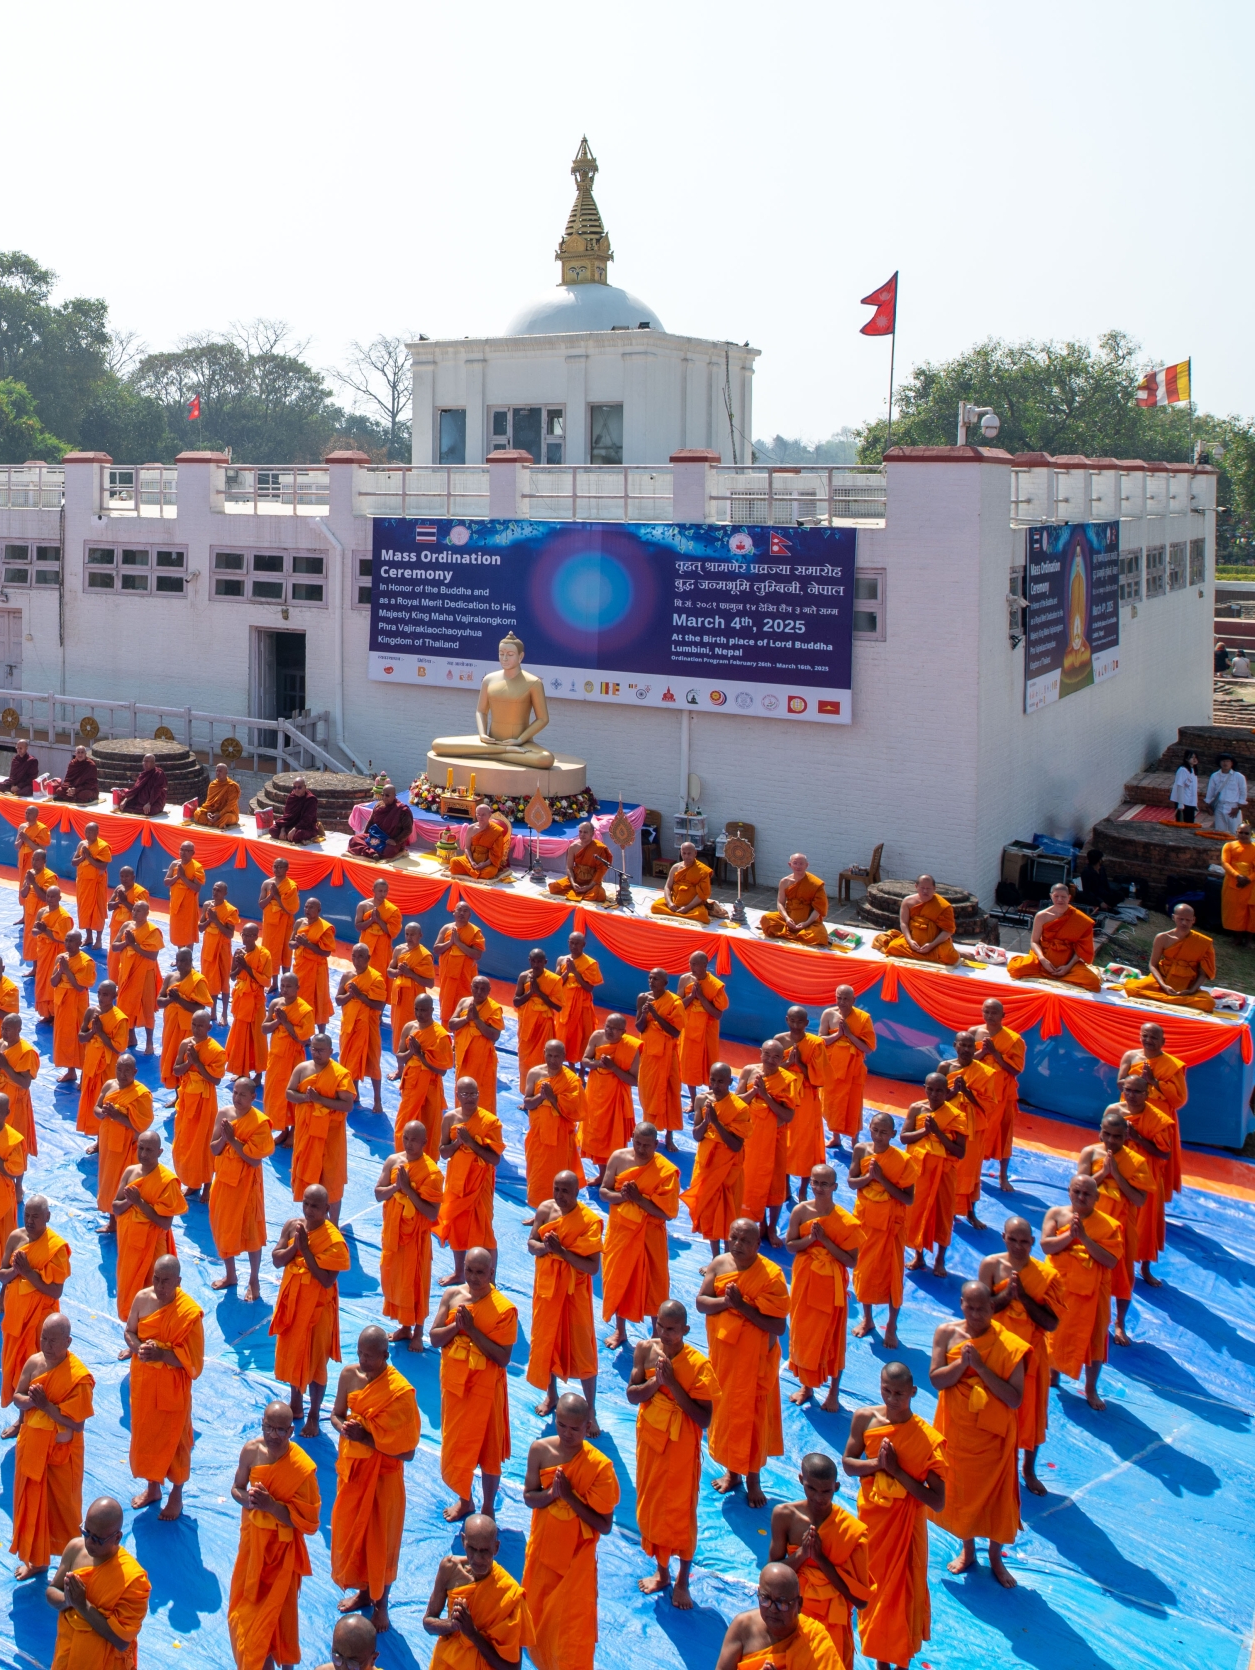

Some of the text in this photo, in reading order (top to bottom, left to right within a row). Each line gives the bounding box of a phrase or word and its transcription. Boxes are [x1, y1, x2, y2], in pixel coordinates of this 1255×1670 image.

[381, 549, 501, 565] Mass Ordination
[380, 566, 453, 583] Ceremony
[705, 560, 747, 573] श्रामणेर
[794, 563, 843, 578] समारोह
[379, 583, 490, 596] In Honor of the Buddha and
[674, 578, 846, 596] बुद्ध जन्मभूमि लुम्बिनी, नेपाल
[397, 597, 420, 608] Royal
[421, 599, 442, 607] Merit
[445, 600, 490, 610] Dedication
[491, 602, 500, 610] to
[502, 603, 516, 611] His
[696, 601, 717, 610] २०८१
[719, 602, 744, 613] फागुन
[746, 603, 756, 611] १४
[758, 603, 777, 612] देखि
[778, 603, 793, 613] चैत्र
[795, 606, 801, 614] ३
[802, 605, 816, 614] गते
[818, 607, 839, 616] सम्म
[379, 609, 517, 626] Majesty King Maha Vajiralongkorn
[672, 613, 806, 633] March 4th, 2025
[378, 623, 482, 637] Phra Vajiraklaochaoyuhua
[378, 635, 459, 649] Kingdom of Thailand
[671, 633, 833, 651] At the Birth place of Lord Buddha
[671, 644, 743, 658] Lumbini, Nepal
[671, 655, 703, 663] Ordination
[703, 657, 729, 666] Program
[729, 659, 757, 668] February
